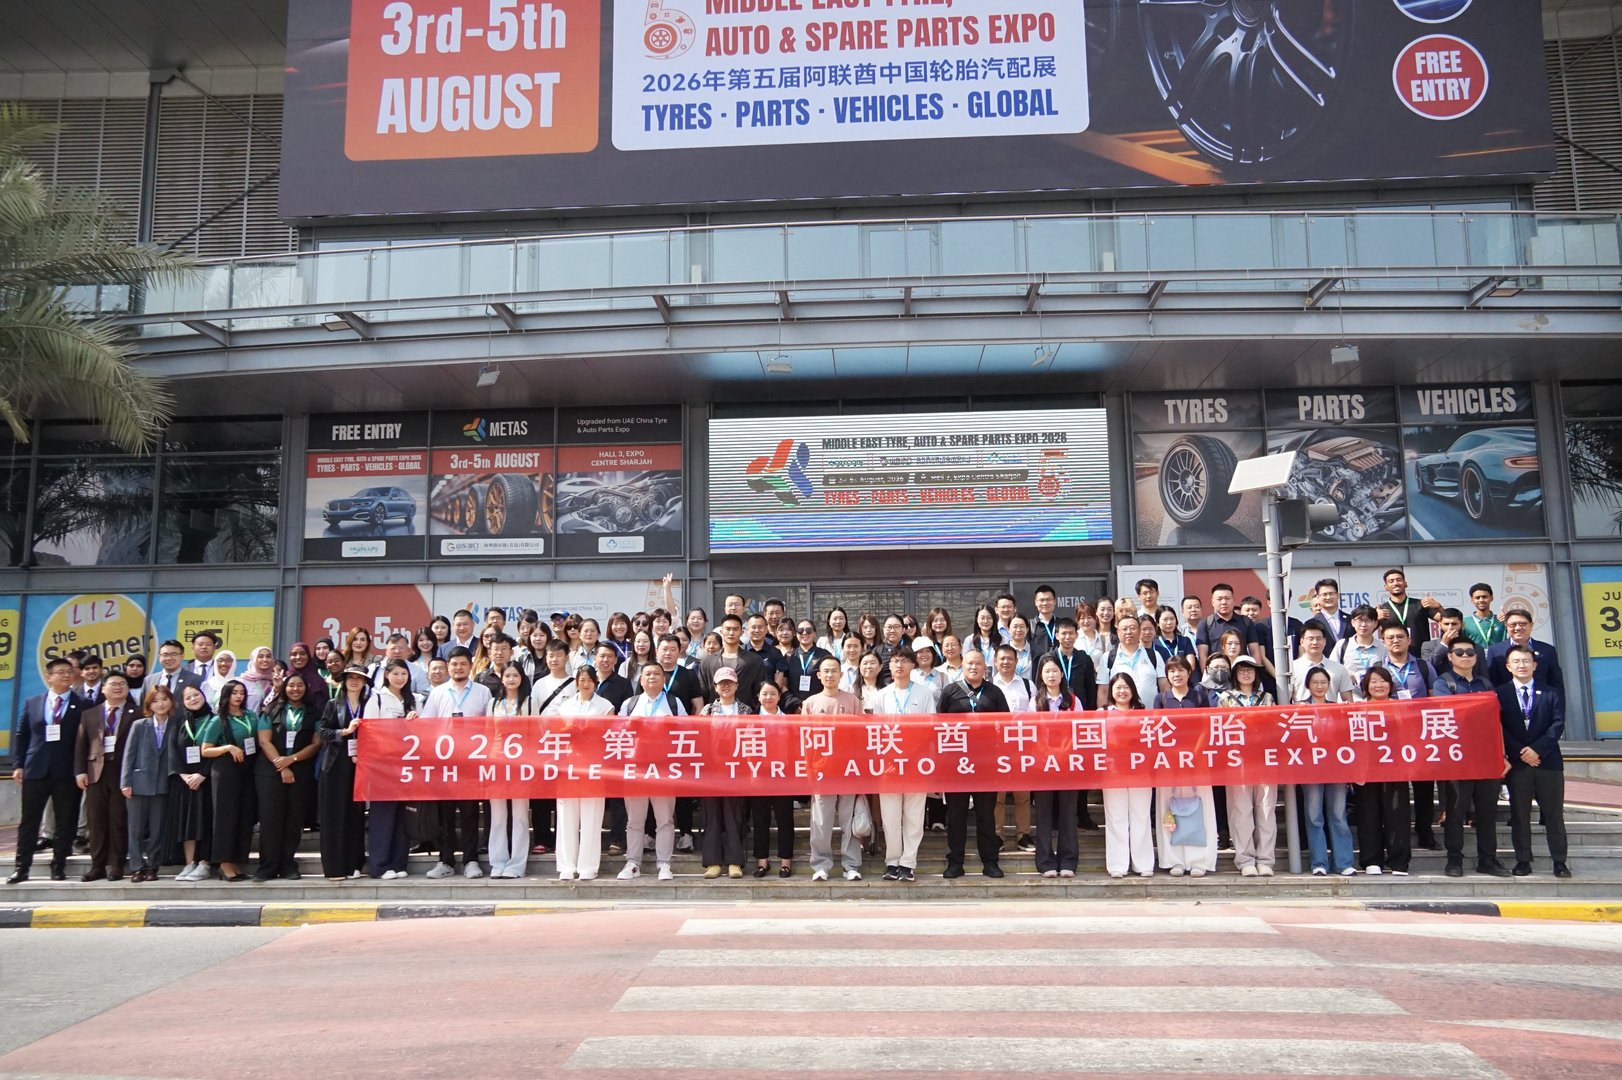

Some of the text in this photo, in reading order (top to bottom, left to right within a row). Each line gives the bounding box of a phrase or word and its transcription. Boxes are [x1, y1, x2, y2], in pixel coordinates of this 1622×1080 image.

[381, 0, 566, 55] 3rd-5th
[705, 12, 1055, 56] AUTO & SPARE PARTS EXPO
[1415, 50, 1462, 74] FREE
[642, 55, 1056, 92] 2026年第五届阿联酋中国轮胎汽配展
[1410, 77, 1471, 102] ENTRY
[376, 72, 560, 134] AUGUST
[641, 88, 1059, 131] TYRES PARTS VEHICLES GLOBAL
[1164, 398, 1228, 424] TYRES
[1298, 394, 1365, 421] PARTS
[1417, 387, 1517, 415] VEHICLES
[332, 423, 402, 441] FREE ENTRY
[489, 420, 528, 437] METAS
[576, 418, 606, 426] Upgraded
[655, 417, 668, 425] Tyre
[615, 426, 630, 434] Expo
[822, 431, 1067, 450] MIDDLE EAST TYRE, AUTO & SPARE PARTS EXPO 2026
[450, 452, 540, 469] 3rd-5th AUGUST
[591, 458, 653, 467] CENTRE SHARJAH
[618, 450, 625, 458] 3,
[317, 461, 421, 473] TYRES PARTS VEHICLES GLOBAL
[1339, 591, 1370, 609] ETAS
[52, 630, 77, 645] the
[233, 622, 270, 635] FREE
[401, 708, 1459, 761] 2026年第五届阿联酋中国轮胎汽配展
[400, 743, 1464, 783] 5TH MIDDLE EAST TYRE, AUTO & SPARE PARTS EXPO 2026
